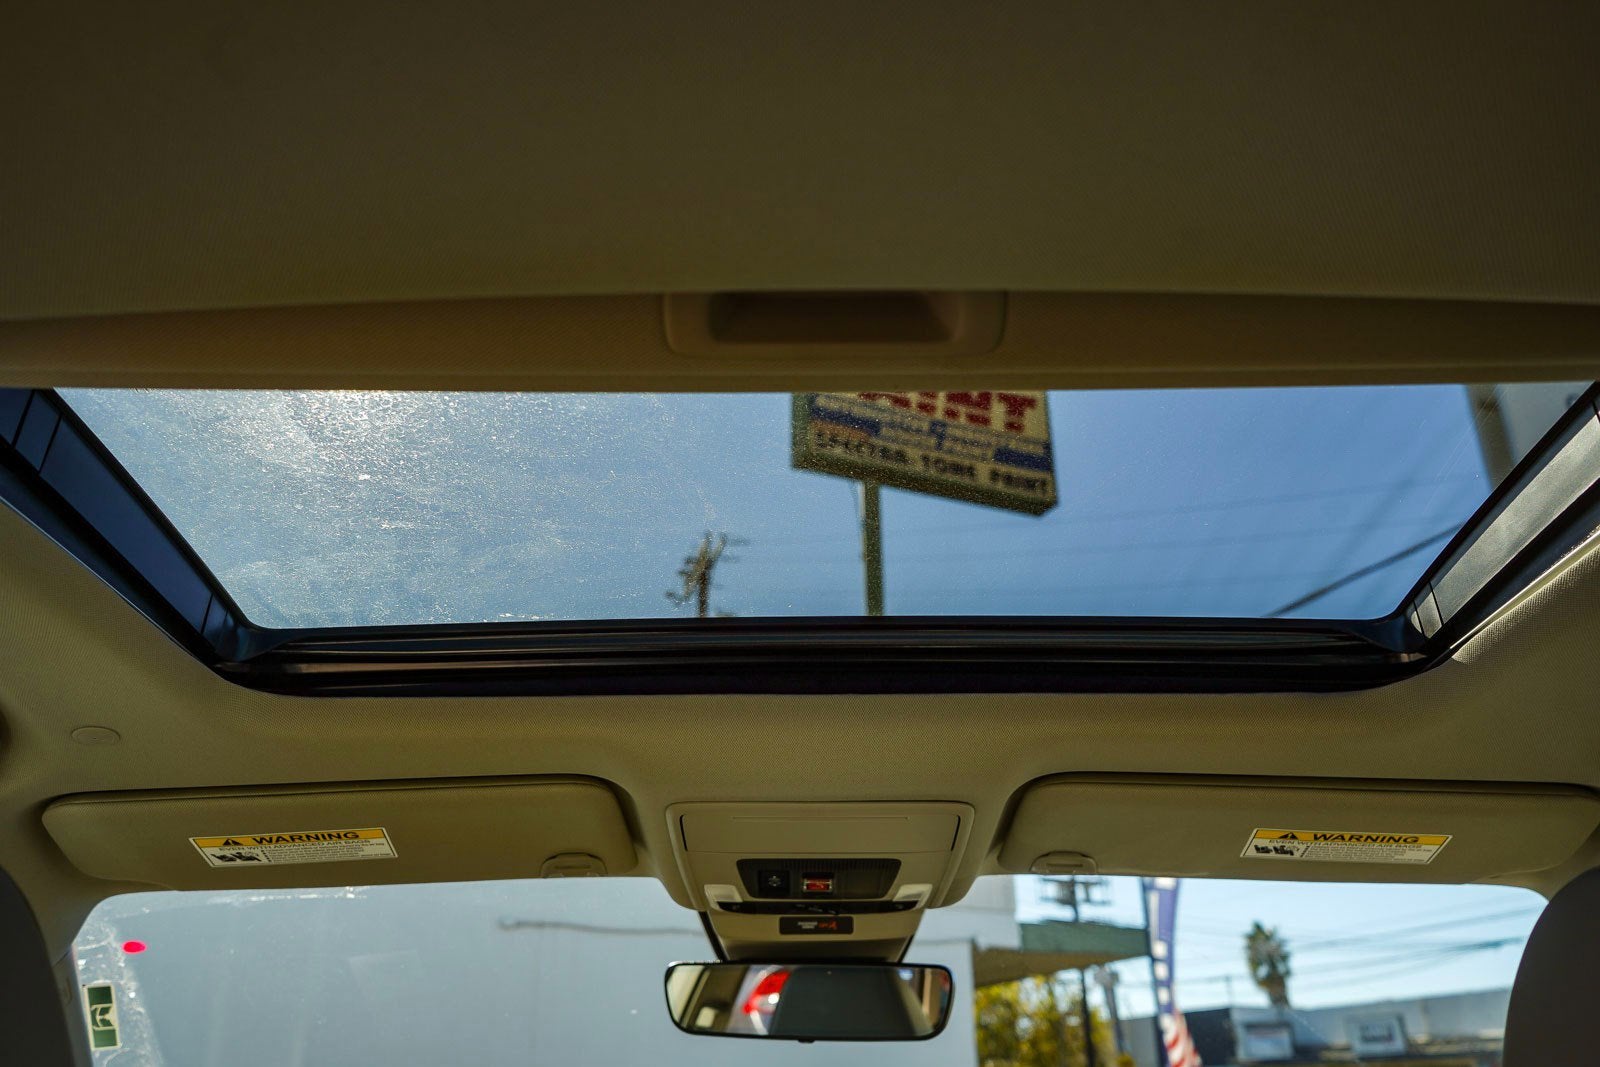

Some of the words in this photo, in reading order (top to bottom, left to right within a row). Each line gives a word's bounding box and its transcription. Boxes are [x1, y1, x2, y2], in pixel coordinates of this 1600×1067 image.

[253, 831, 360, 845] WARNING
[1312, 832, 1420, 844] WARNING
[269, 840, 325, 850] ADVANCED
